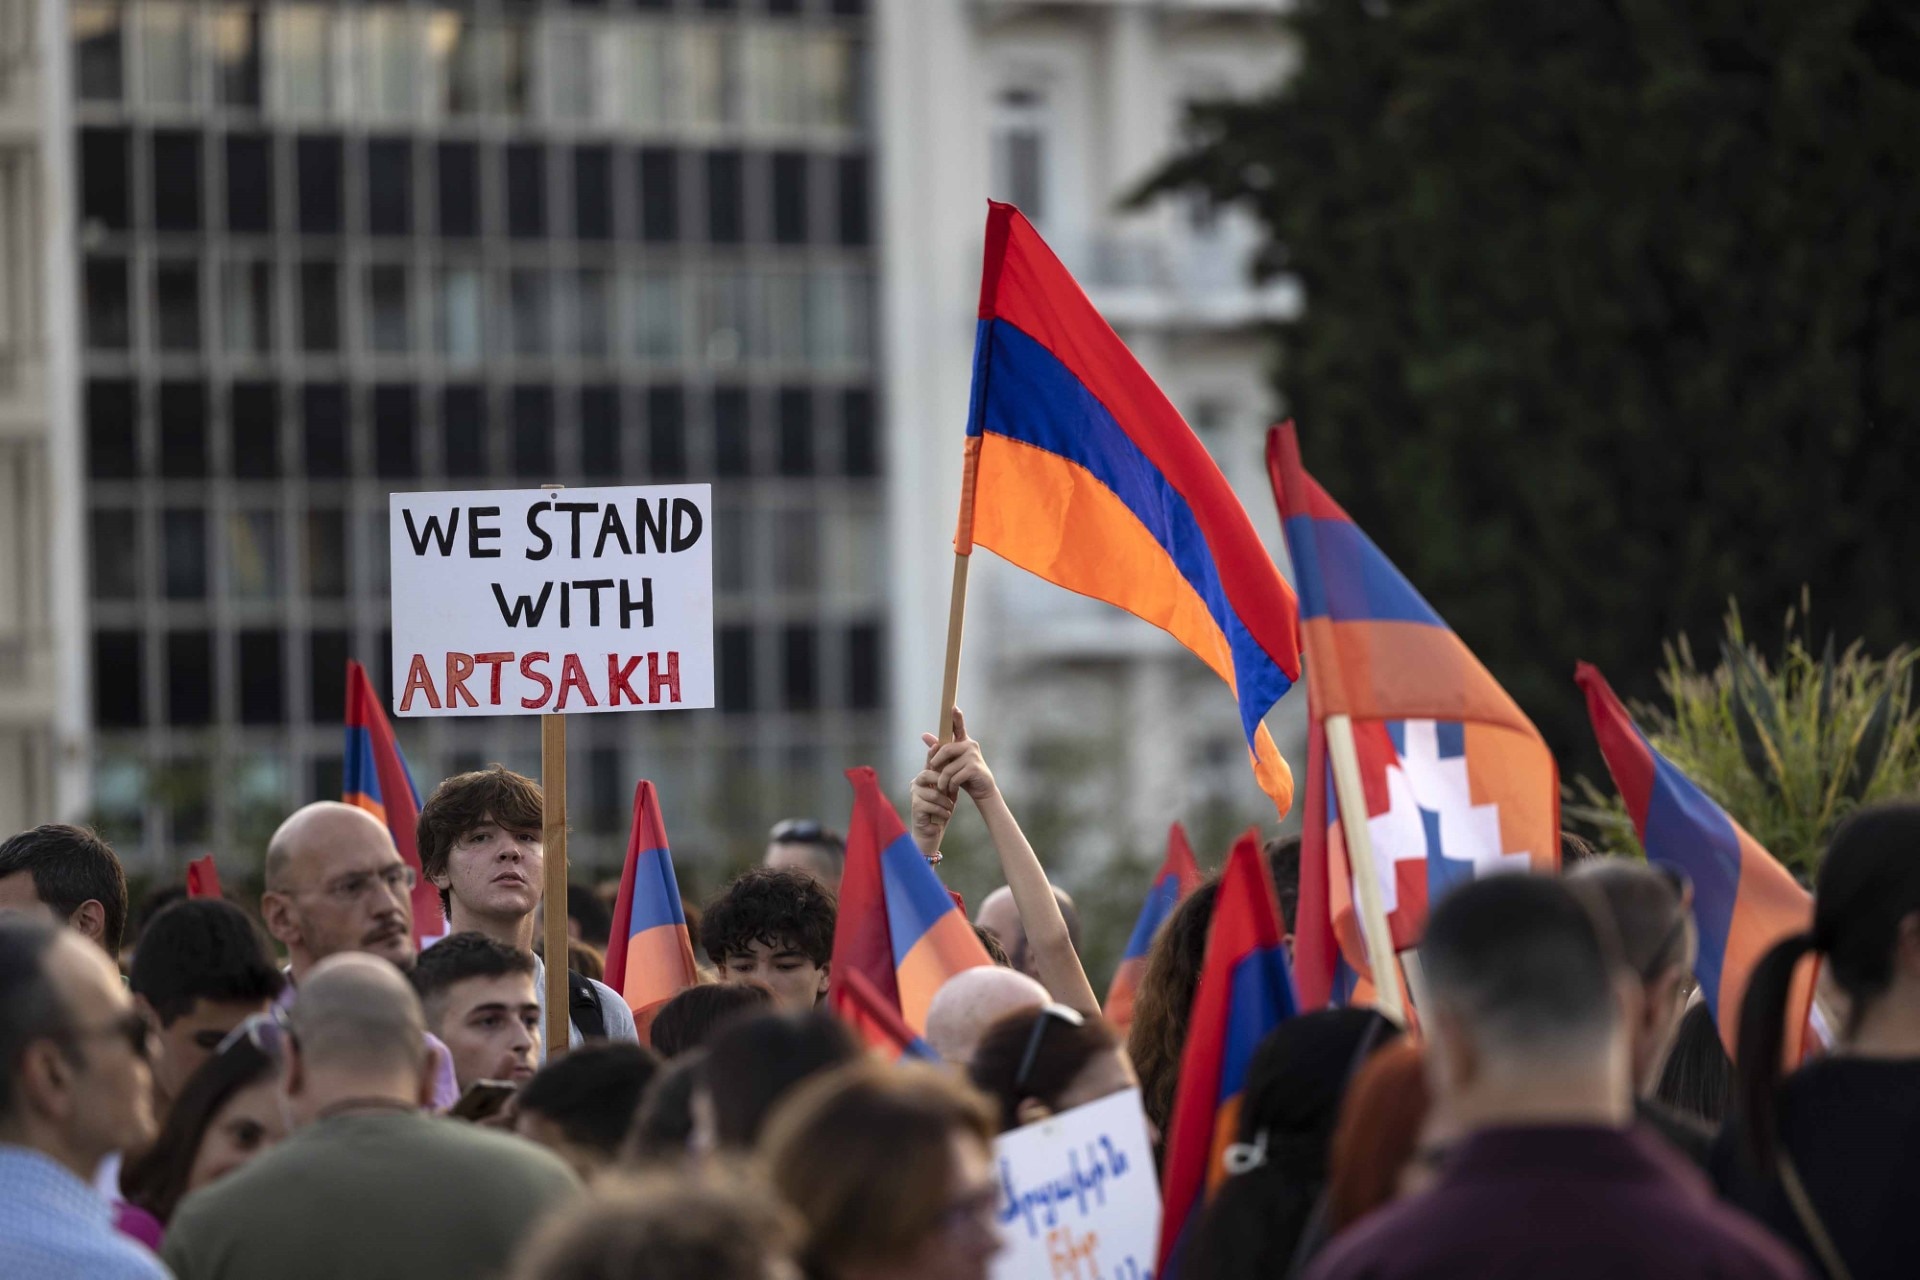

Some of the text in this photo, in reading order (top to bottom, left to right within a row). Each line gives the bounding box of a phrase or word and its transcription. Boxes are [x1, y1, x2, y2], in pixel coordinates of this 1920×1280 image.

[402, 497, 703, 561] WE STAND
[491, 577, 654, 629] WITH
[399, 651, 682, 711] ARTSAKH
